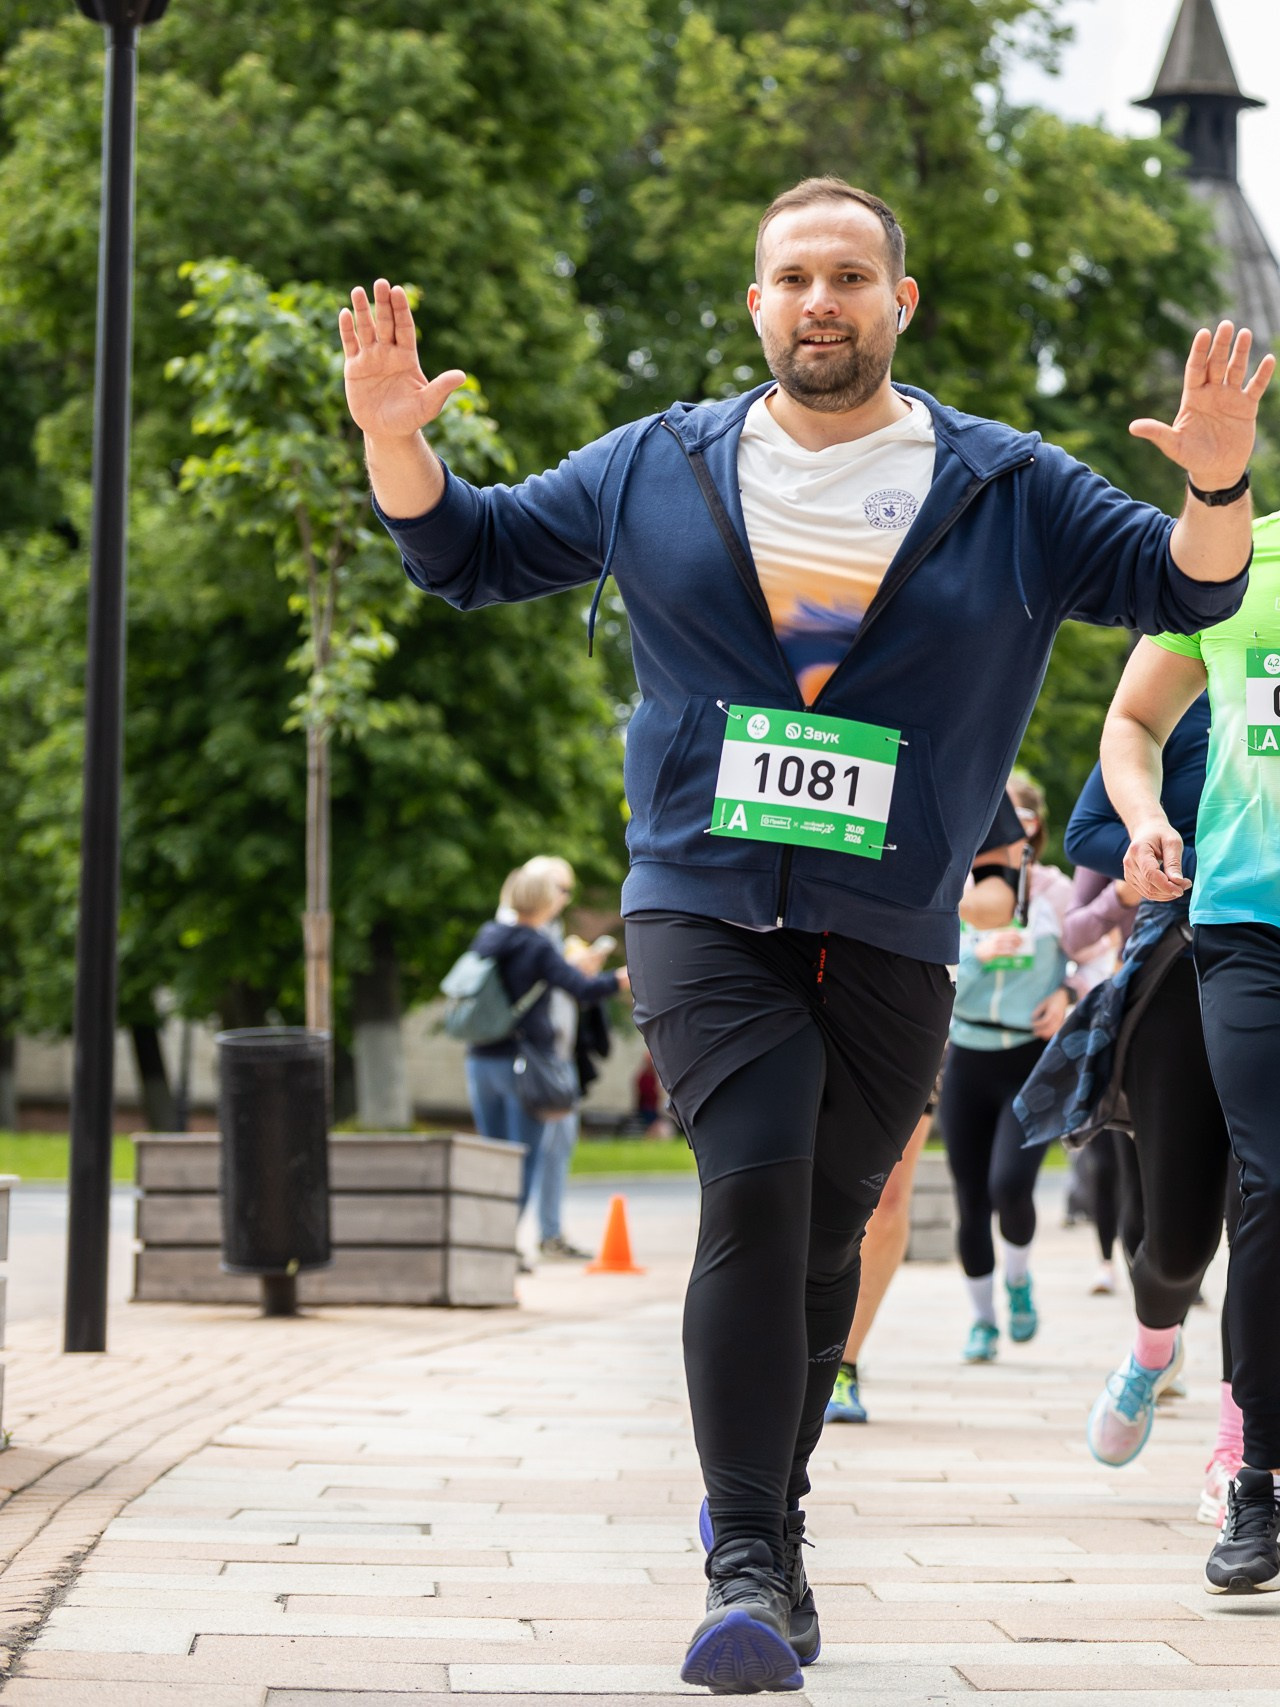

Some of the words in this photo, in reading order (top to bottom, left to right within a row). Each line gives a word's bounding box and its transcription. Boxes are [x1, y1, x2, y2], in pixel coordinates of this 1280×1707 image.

[874, 521, 907, 529] МАРАФОН
[803, 726, 840, 745] Звук
[754, 752, 860, 807] 1081
